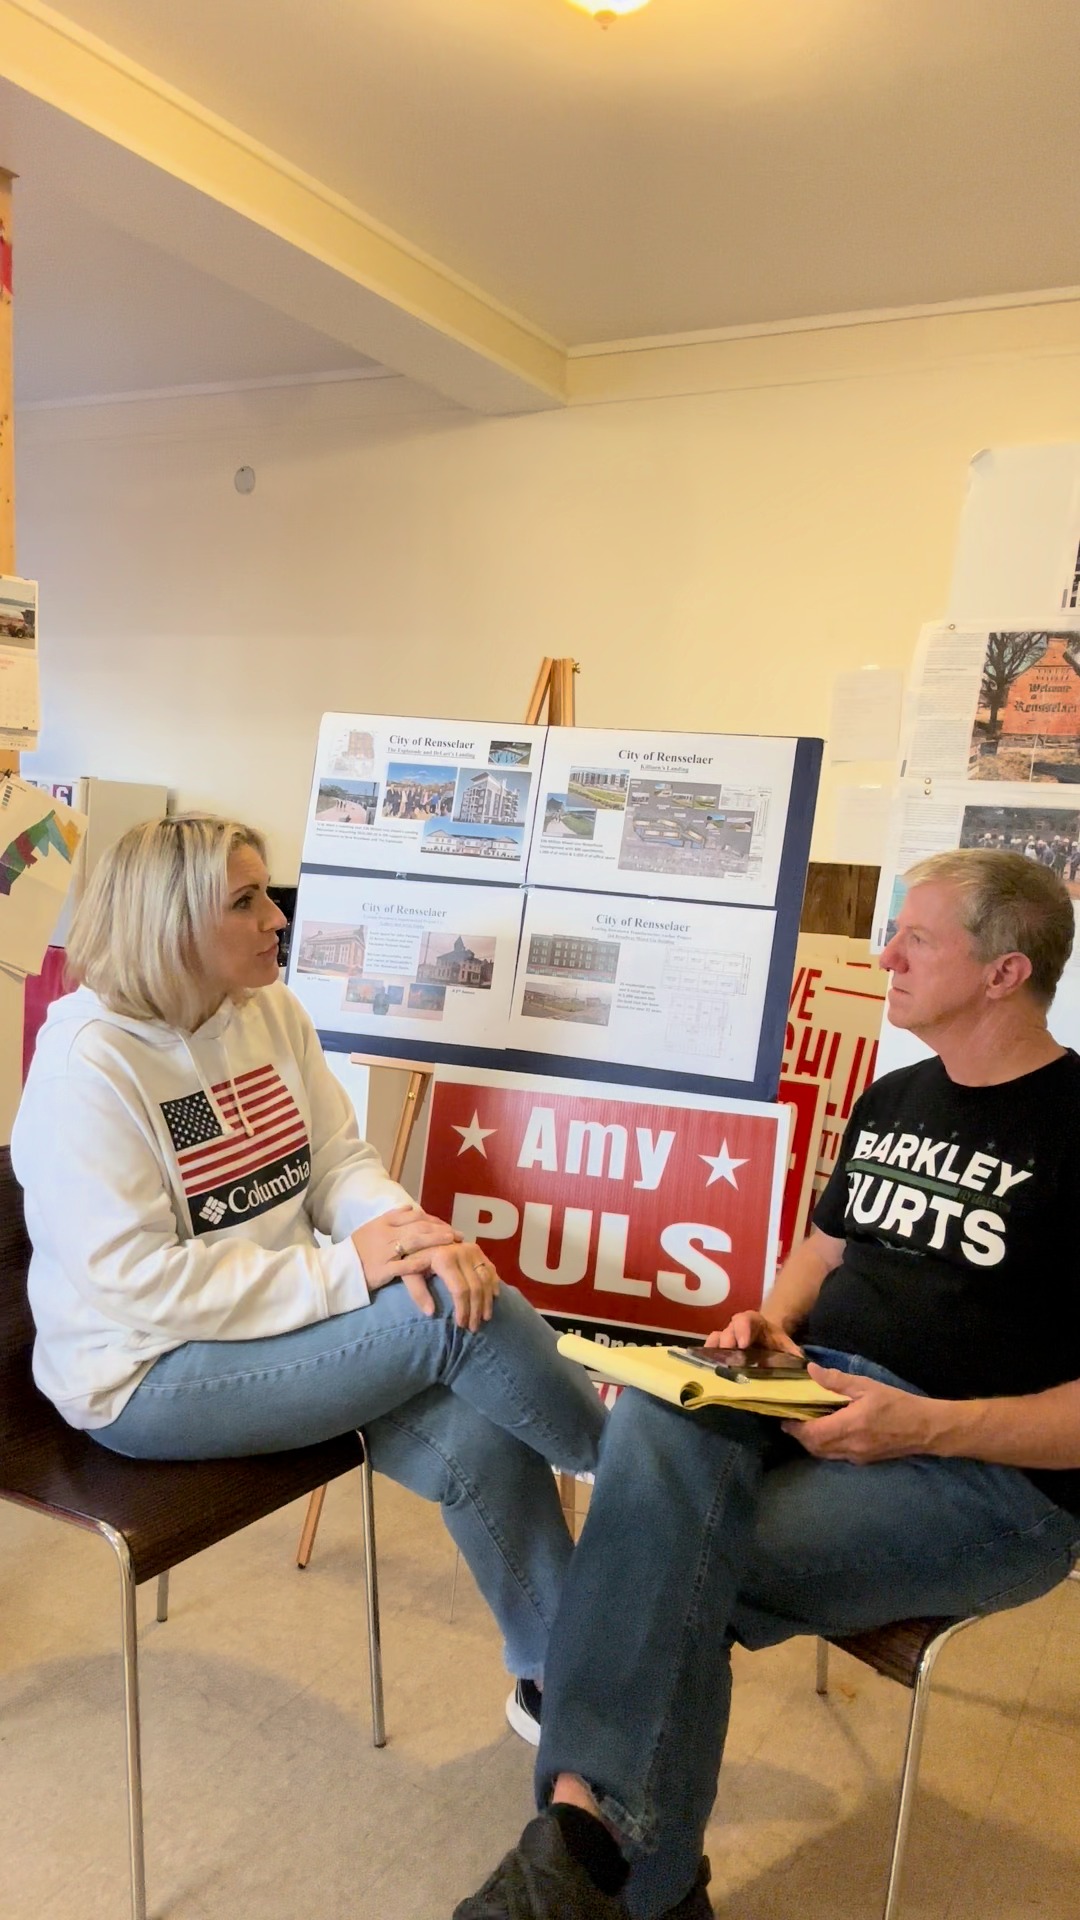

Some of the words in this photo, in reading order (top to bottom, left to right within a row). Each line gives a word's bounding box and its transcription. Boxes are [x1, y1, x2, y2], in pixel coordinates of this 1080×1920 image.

[389, 734, 409, 747] City
[412, 736, 423, 746] of
[424, 737, 475, 749] Rensselaer
[618, 749, 640, 762] City
[643, 751, 655, 761] of
[657, 751, 713, 764] Rensselaer
[362, 902, 380, 915] City
[384, 904, 395, 913] of
[396, 905, 447, 918] Rensselaer
[596, 913, 617, 927] City
[621, 917, 633, 927] of
[634, 917, 691, 932] Rensselaer
[517, 1106, 676, 1191] Amy
[852, 1130, 1033, 1198] BARKLEY
[227, 1157, 310, 1214] Columbia
[451, 1192, 733, 1307] PULS
